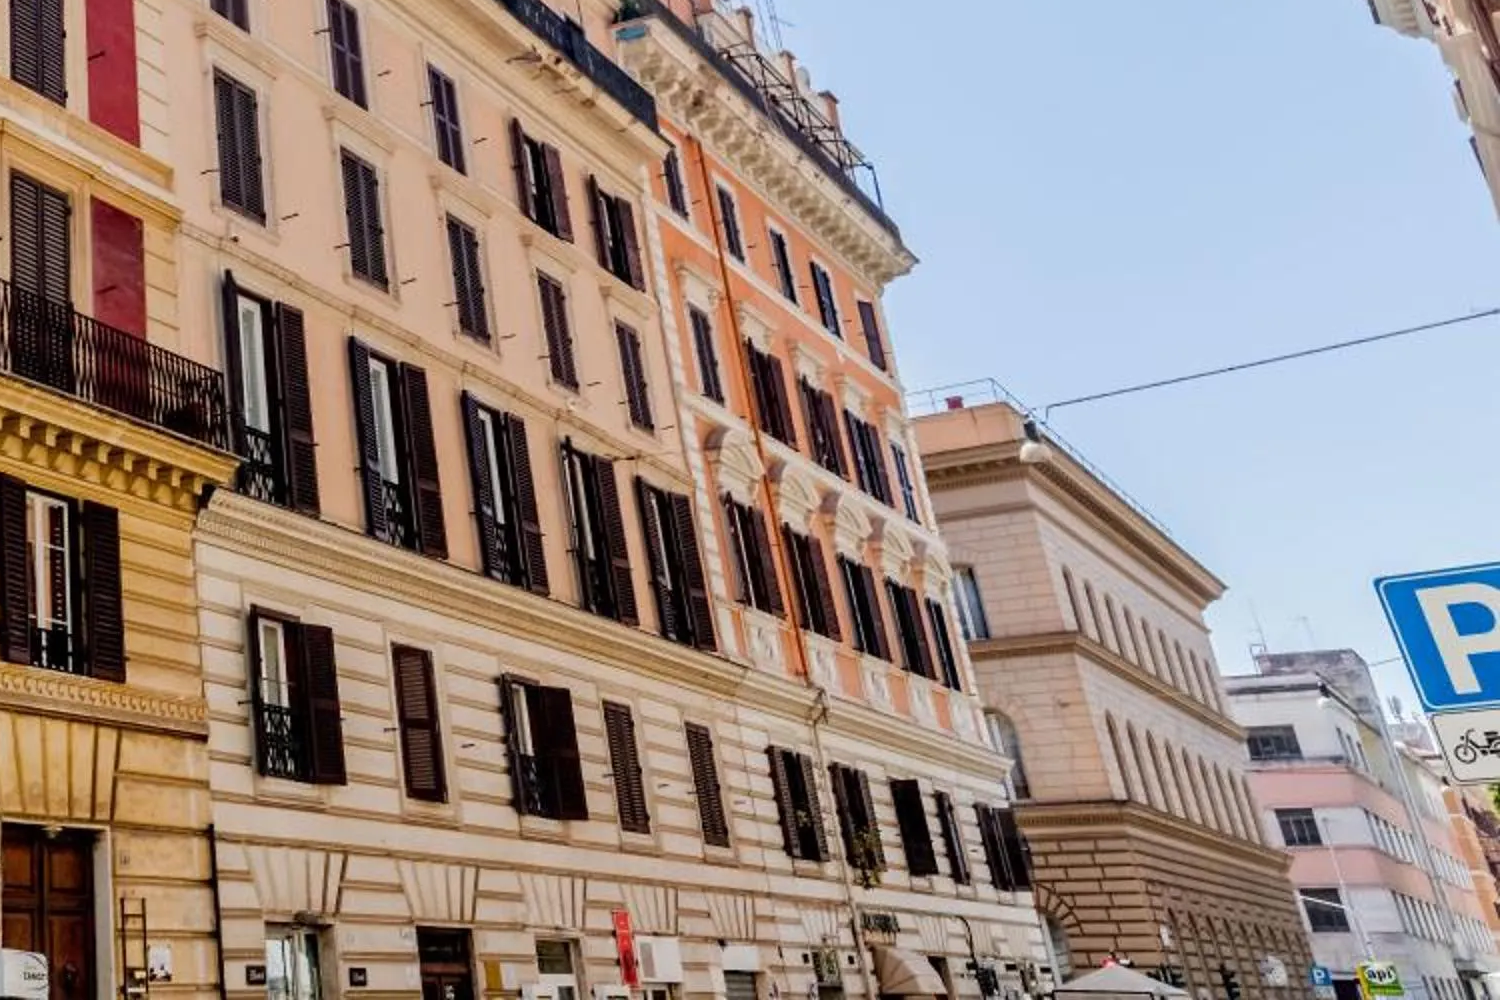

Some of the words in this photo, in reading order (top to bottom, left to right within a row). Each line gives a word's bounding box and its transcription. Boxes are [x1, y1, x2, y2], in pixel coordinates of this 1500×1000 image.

[1414, 582, 1500, 695] P
[1313, 968, 1325, 985] P
[1366, 965, 1393, 982] api
